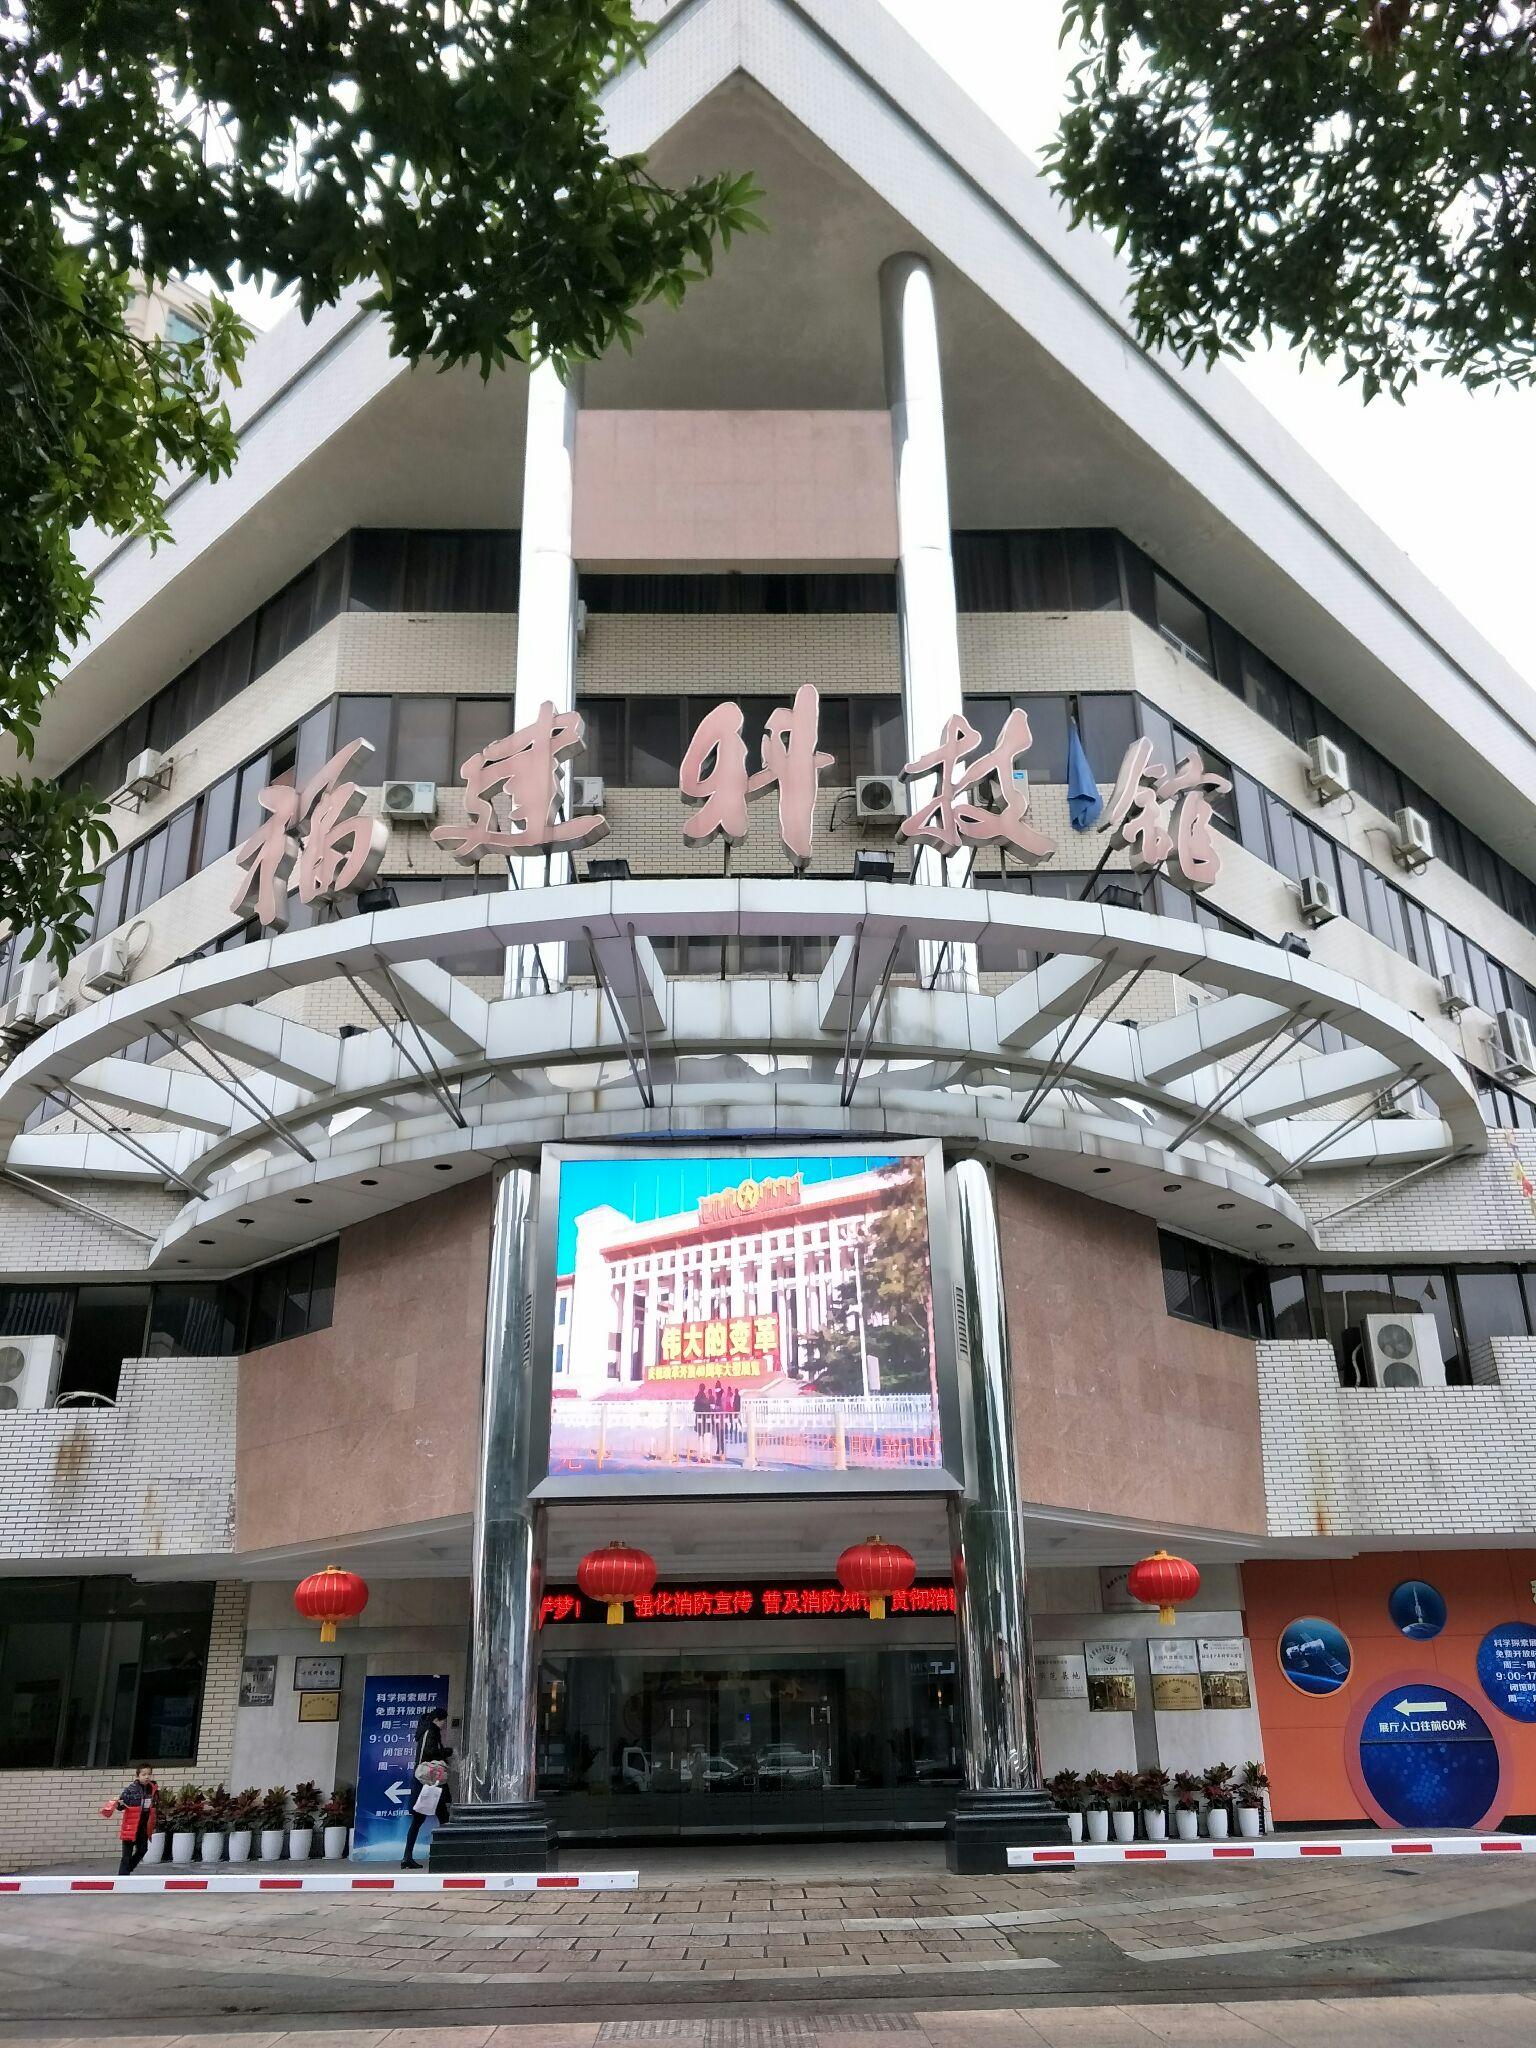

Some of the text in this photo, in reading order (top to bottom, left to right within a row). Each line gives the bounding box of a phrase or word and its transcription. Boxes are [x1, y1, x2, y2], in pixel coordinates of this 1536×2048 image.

[661, 1316, 778, 1361] 伟大的变革
[633, 1590, 753, 1617] 强化消防宣传
[376, 1692, 437, 1702] 科学探索展厅
[1379, 1720, 1467, 1733] 展厅入口往前60米
